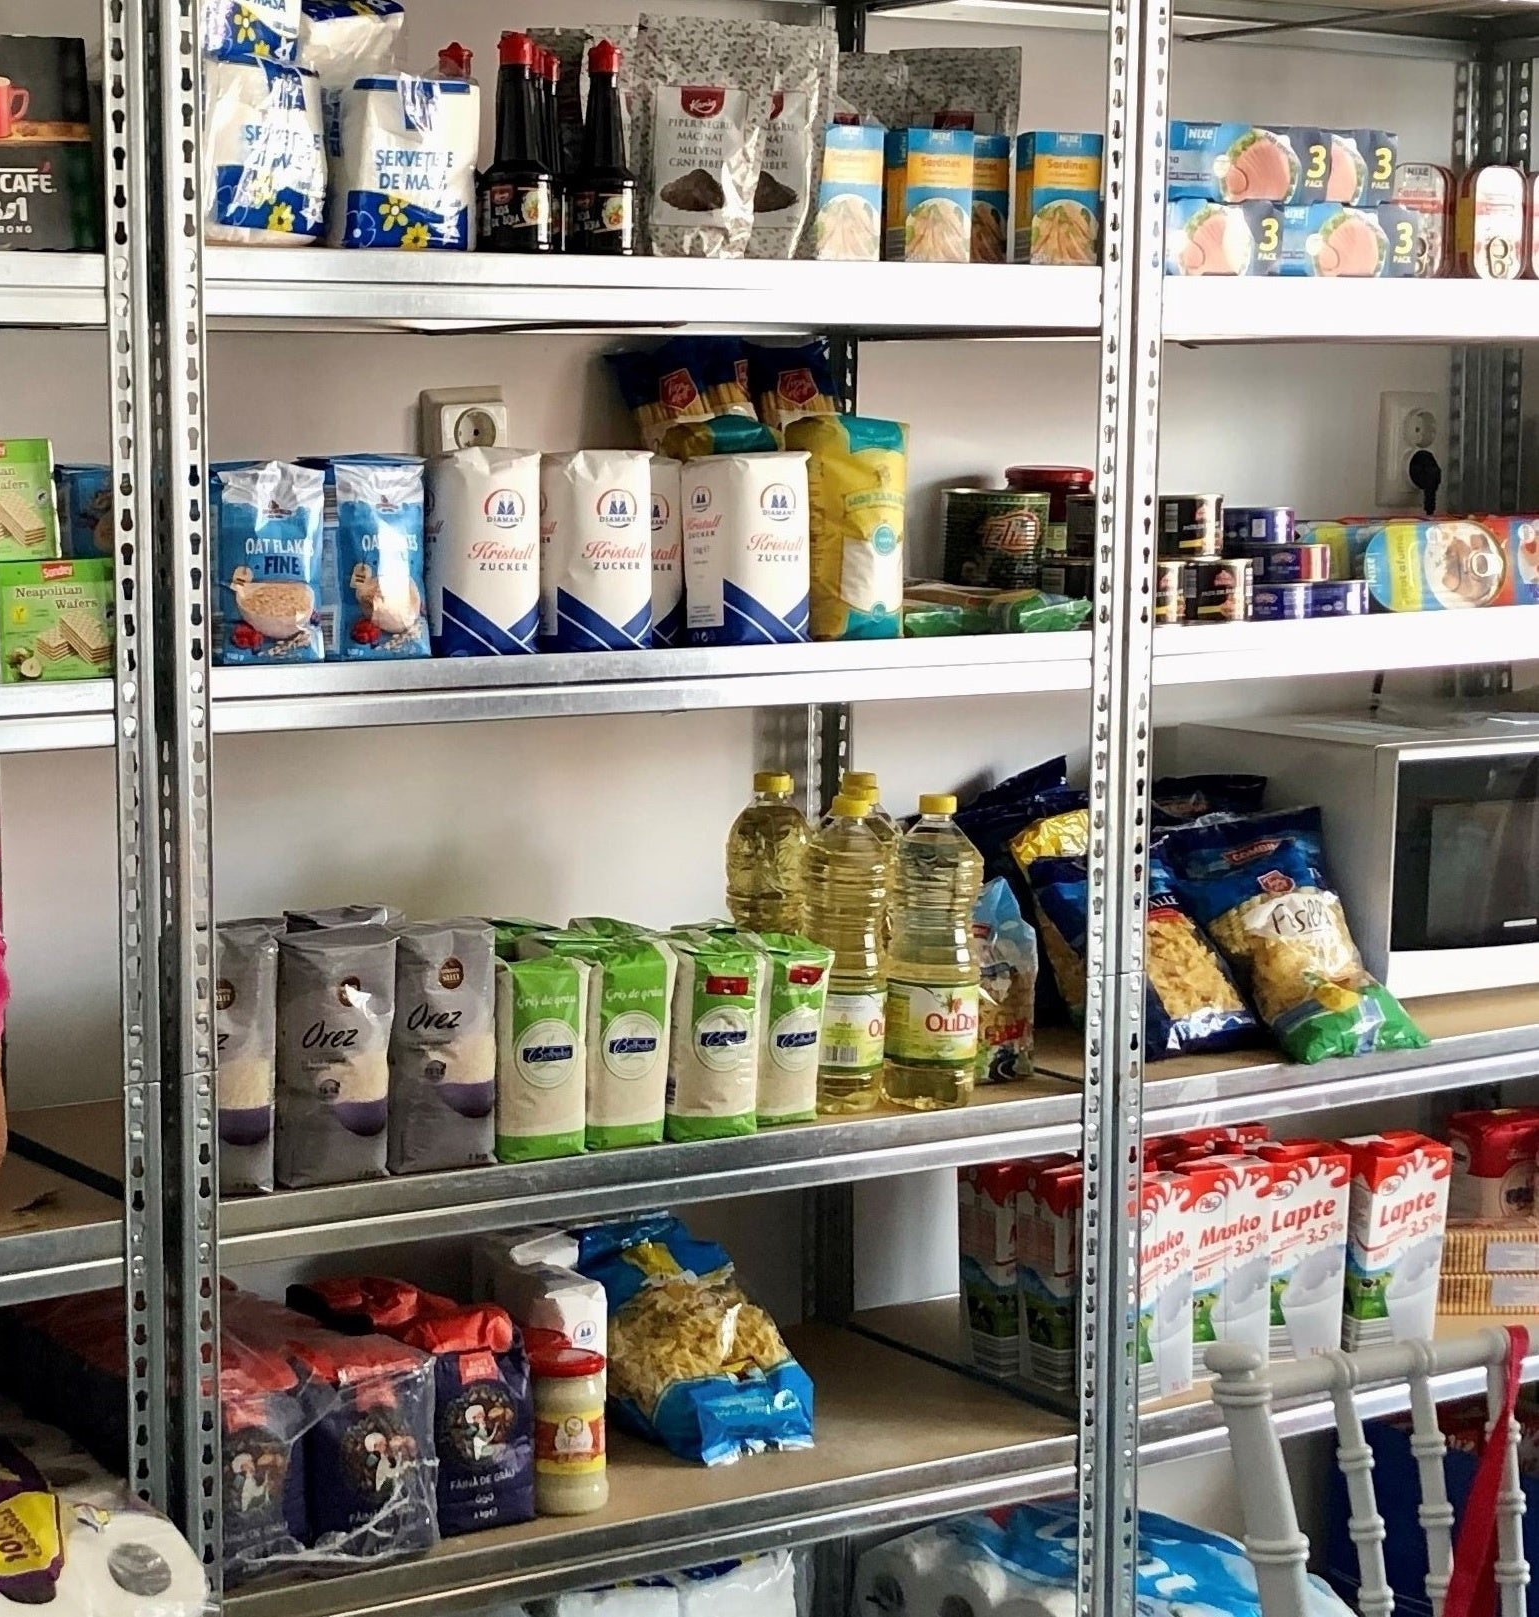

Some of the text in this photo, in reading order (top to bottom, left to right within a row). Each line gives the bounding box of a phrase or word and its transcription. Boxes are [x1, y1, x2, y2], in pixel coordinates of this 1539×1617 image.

[1307, 145, 1327, 178] 3
[1373, 147, 1393, 180] 3
[379, 173, 400, 189] DE
[1305, 180, 1324, 188] PACK
[1372, 182, 1391, 190] PACK
[1259, 217, 1279, 251] 3
[1395, 222, 1413, 254] 3
[1258, 252, 1277, 261] PACK
[1393, 256, 1412, 264] PACK
[487, 515, 524, 524] DIAMANT
[599, 515, 637, 523] DIAMANT
[245, 537, 269, 554] OAT
[362, 535, 379, 551] OA
[468, 541, 536, 560] Kristall
[582, 541, 647, 559] Kristall
[747, 533, 804, 552] Kristall
[264, 556, 301, 575] FINE
[593, 562, 641, 570] ZUCKER
[757, 554, 800, 562] ZUCKER
[479, 562, 529, 571] ZUCKER
[653, 563, 673, 571] KER
[16, 586, 82, 599] Neapolitan
[55, 598, 98, 609] Wafers
[407, 1002, 463, 1031] Orez
[302, 1021, 359, 1049] Orez
[1272, 1199, 1337, 1233] Lapte
[1379, 1191, 1437, 1228] Lapte
[1199, 1214, 1262, 1250] Мляко
[480, 1473, 492, 1485] DE
